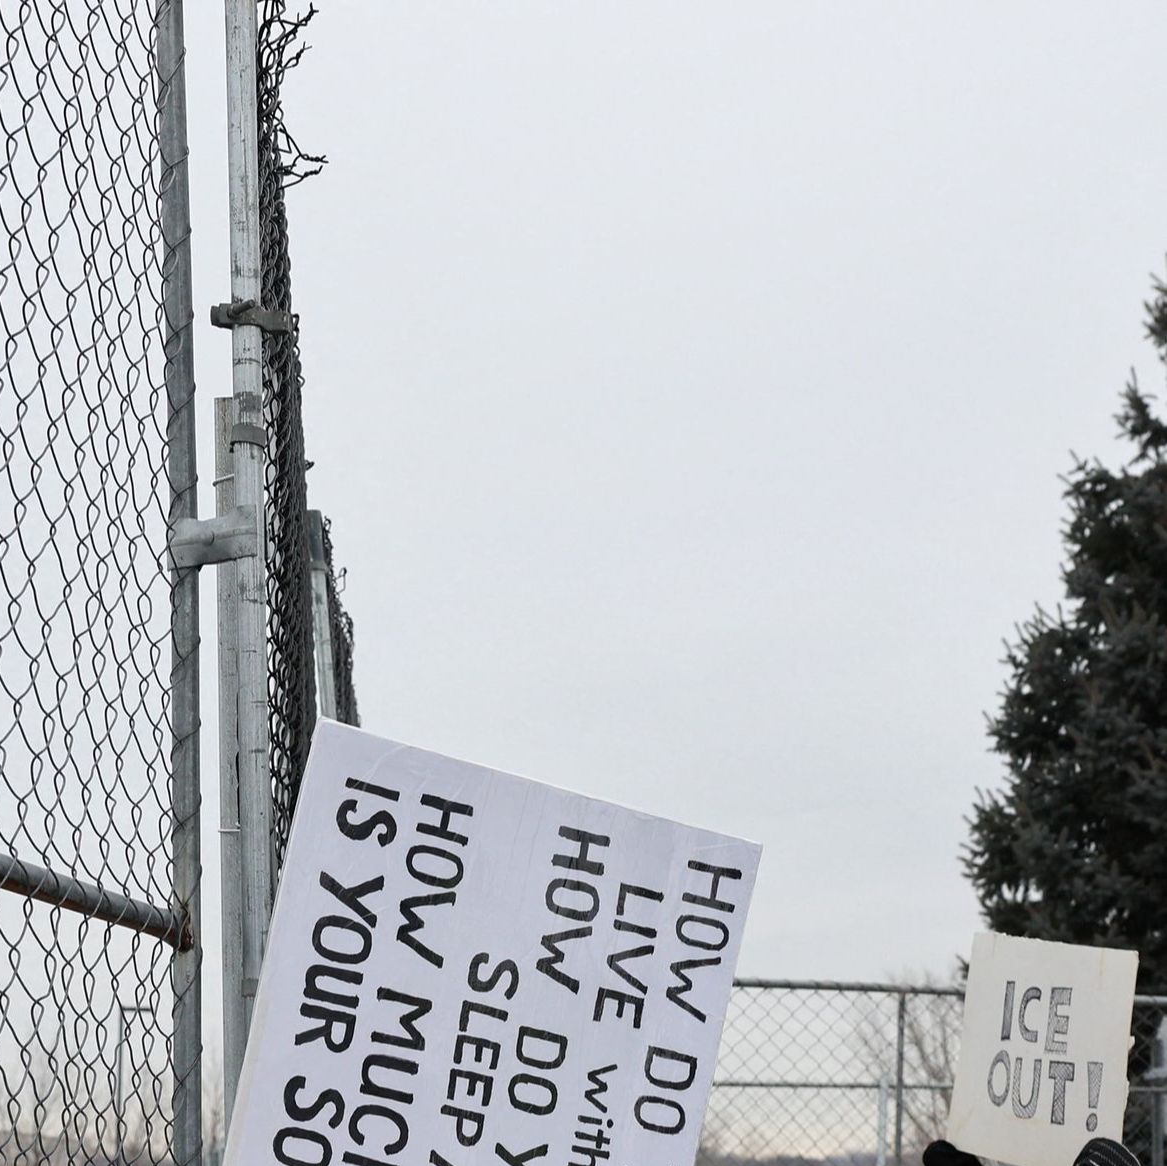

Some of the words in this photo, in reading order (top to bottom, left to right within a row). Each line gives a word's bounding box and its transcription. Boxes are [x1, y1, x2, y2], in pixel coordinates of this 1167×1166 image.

[336, 777, 400, 848] IS
[396, 793, 473, 968] HOW
[294, 871, 385, 1053] YOUR
[536, 825, 611, 995] HOW
[592, 883, 664, 1029] LIVE
[666, 860, 742, 1023] HOW
[441, 952, 520, 1147] SLEEP
[508, 1025, 568, 1116] DO
[634, 1046, 698, 1135] DO
[1000, 980, 1073, 1055] ICE
[986, 1049, 1104, 1133] OUT!
